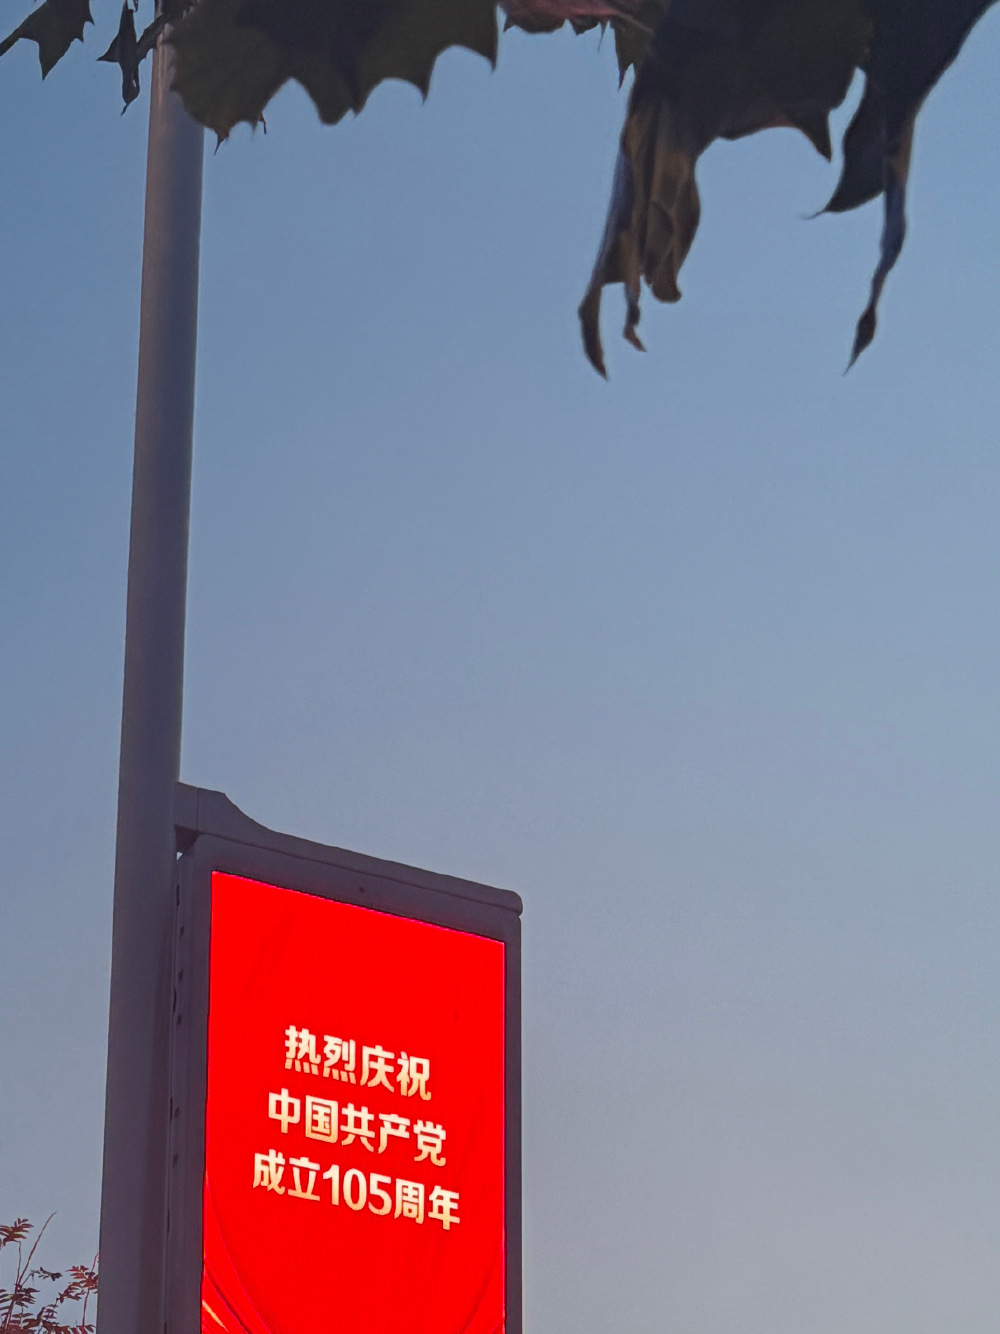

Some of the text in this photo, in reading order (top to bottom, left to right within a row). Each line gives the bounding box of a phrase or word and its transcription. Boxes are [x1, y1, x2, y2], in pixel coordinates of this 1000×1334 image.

[284, 1024, 432, 1101] 热烈庆祝
[267, 1087, 447, 1167] 中国共产党
[252, 1149, 461, 1231] 成立105周年
